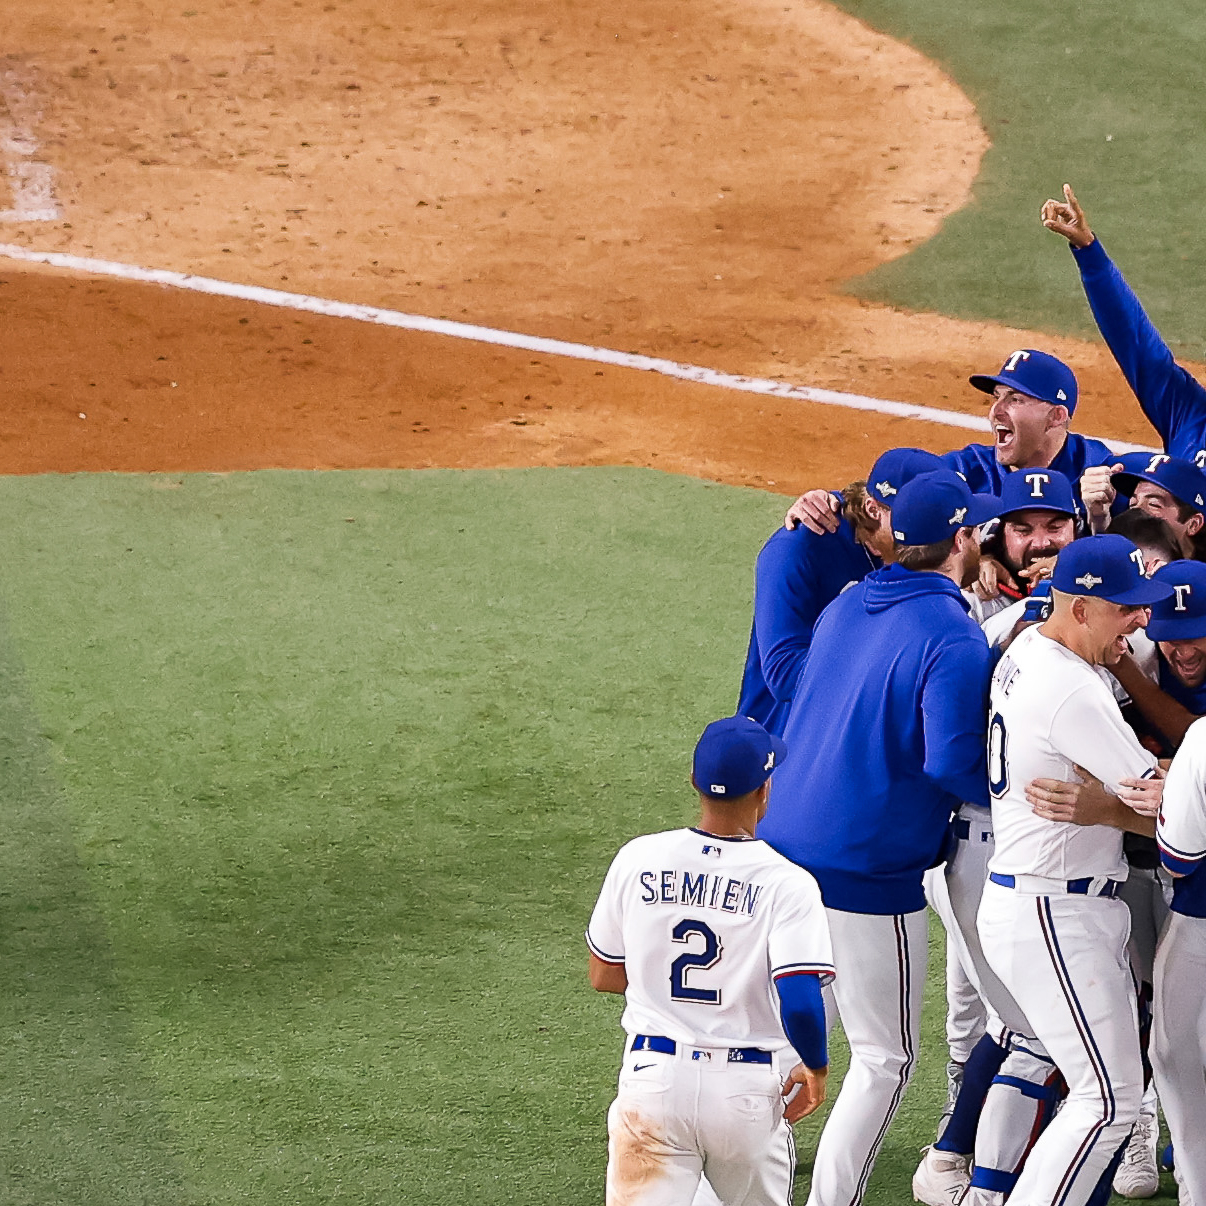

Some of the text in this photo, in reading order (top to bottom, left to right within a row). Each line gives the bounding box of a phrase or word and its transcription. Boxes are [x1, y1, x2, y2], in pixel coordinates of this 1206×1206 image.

[1005, 350, 1031, 372] T
[1145, 454, 1171, 473] T
[1025, 474, 1050, 497] T
[1173, 585, 1191, 611] T
[640, 870, 763, 917] SEMIEN
[669, 919, 724, 1005] 2
